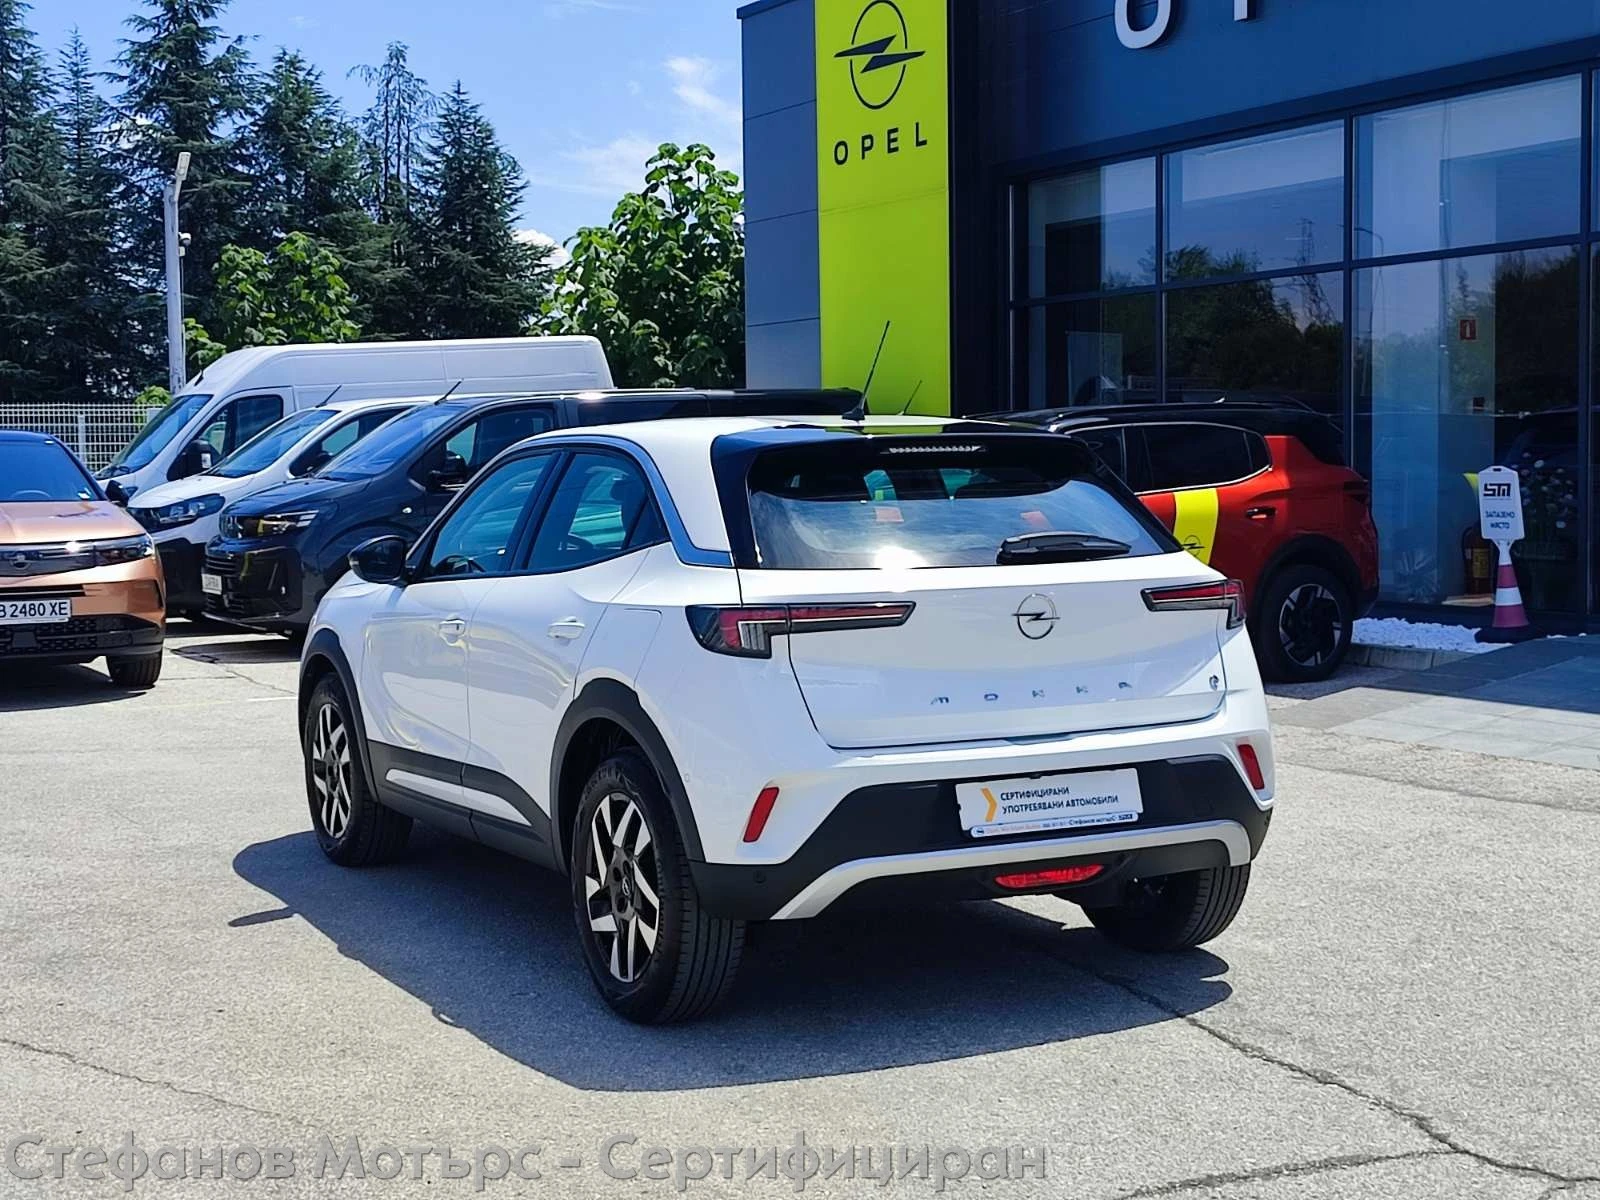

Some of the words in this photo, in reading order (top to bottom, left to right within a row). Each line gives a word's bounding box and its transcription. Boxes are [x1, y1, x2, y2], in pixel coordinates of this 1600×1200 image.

[834, 121, 928, 165] OPEL
[9, 602, 46, 618] 2480
[49, 601, 68, 616] XE
[1000, 787, 1070, 801] СЕРТИФИЦИРАНИ
[1001, 801, 1064, 815] УПОТРЕБЯВАНИ
[1065, 795, 1119, 808] АВТОМОБИЛИ
